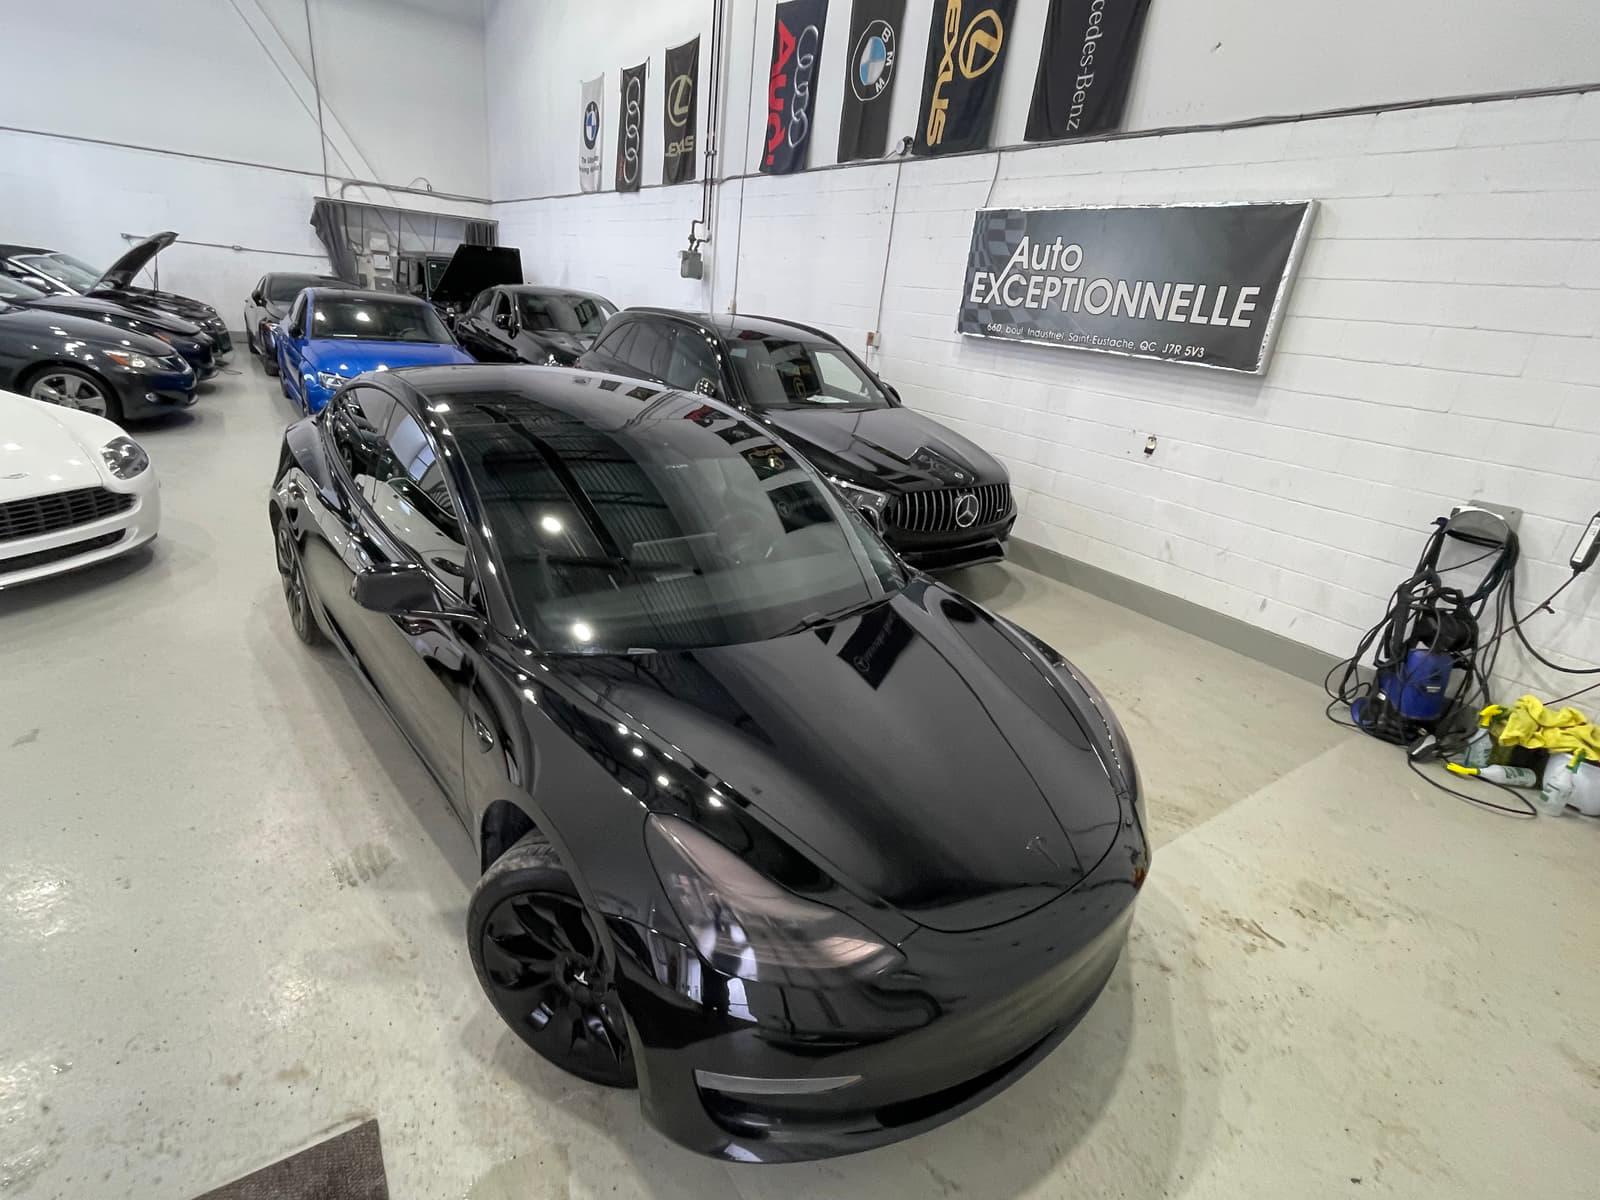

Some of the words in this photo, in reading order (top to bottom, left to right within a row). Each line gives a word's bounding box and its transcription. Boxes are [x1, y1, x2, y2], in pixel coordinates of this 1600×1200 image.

[1000, 236, 1083, 273] Auto
[970, 271, 1261, 328] EXCEPTIONNELLE
[1140, 340, 1158, 352] QC
[1162, 343, 1183, 356] J7R
[1184, 345, 1205, 358] 5V3
